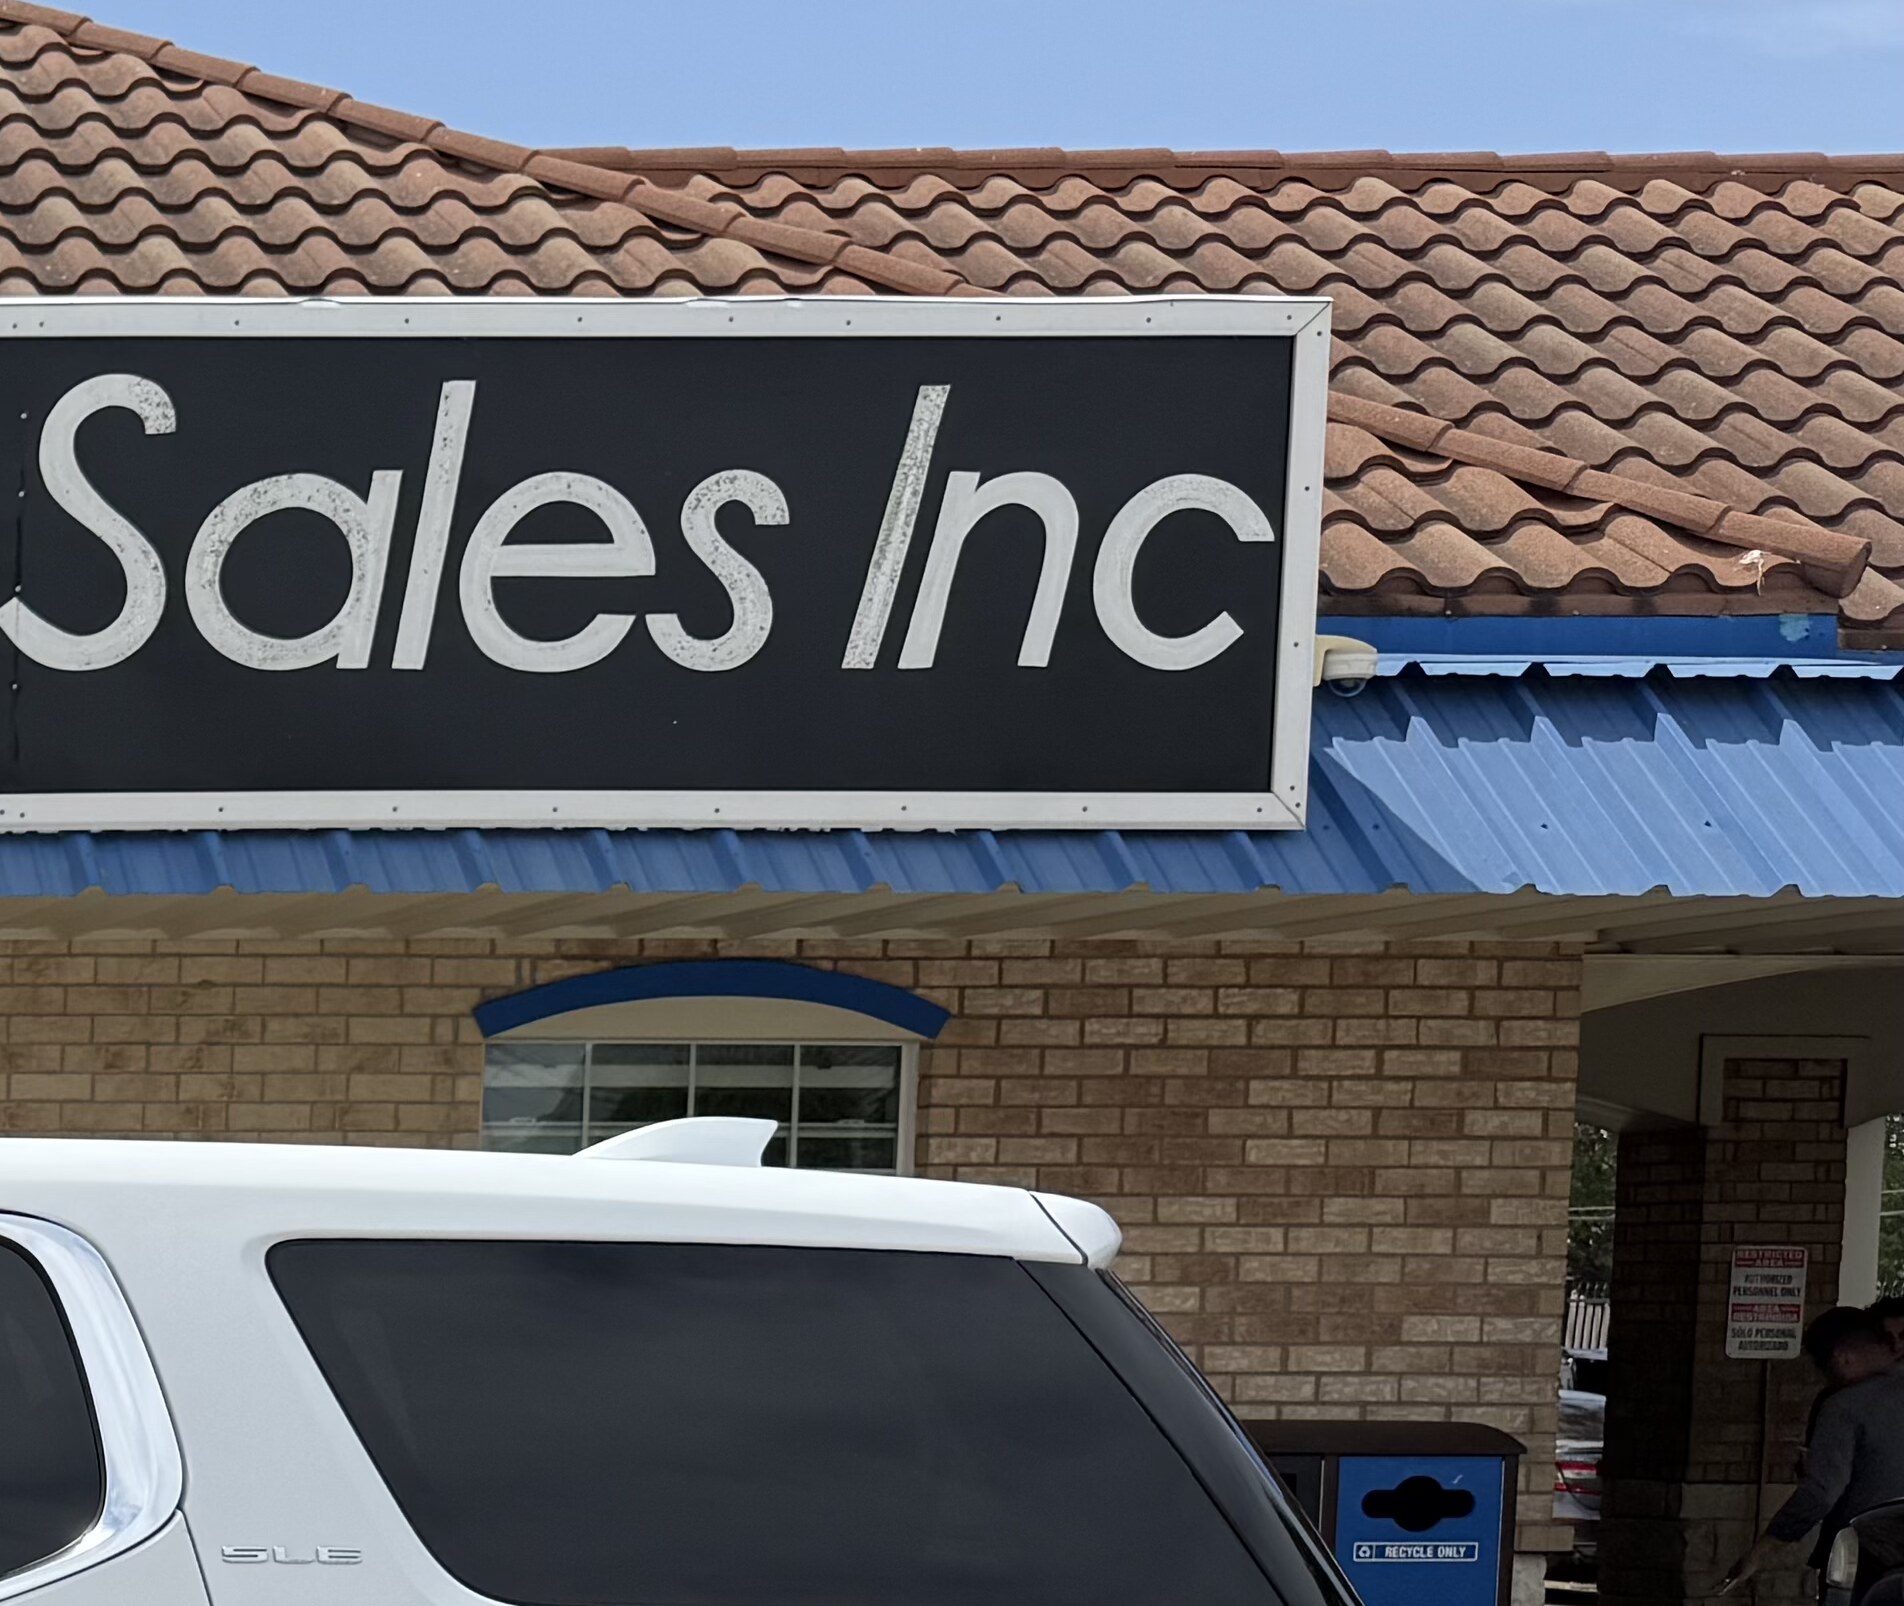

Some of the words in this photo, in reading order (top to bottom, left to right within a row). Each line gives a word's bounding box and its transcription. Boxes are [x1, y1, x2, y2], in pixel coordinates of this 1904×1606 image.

[842, 384, 1275, 670] Inc
[1736, 1250, 1803, 1259] RESTRICTED
[1754, 1259, 1784, 1267] AREA
[1733, 1286, 1778, 1296] PERSONNEL
[1781, 1287, 1801, 1297] ONLY
[221, 1545, 363, 1565] SLE
[1385, 1546, 1433, 1558] RECYCLE
[1437, 1546, 1467, 1558] ONLY
